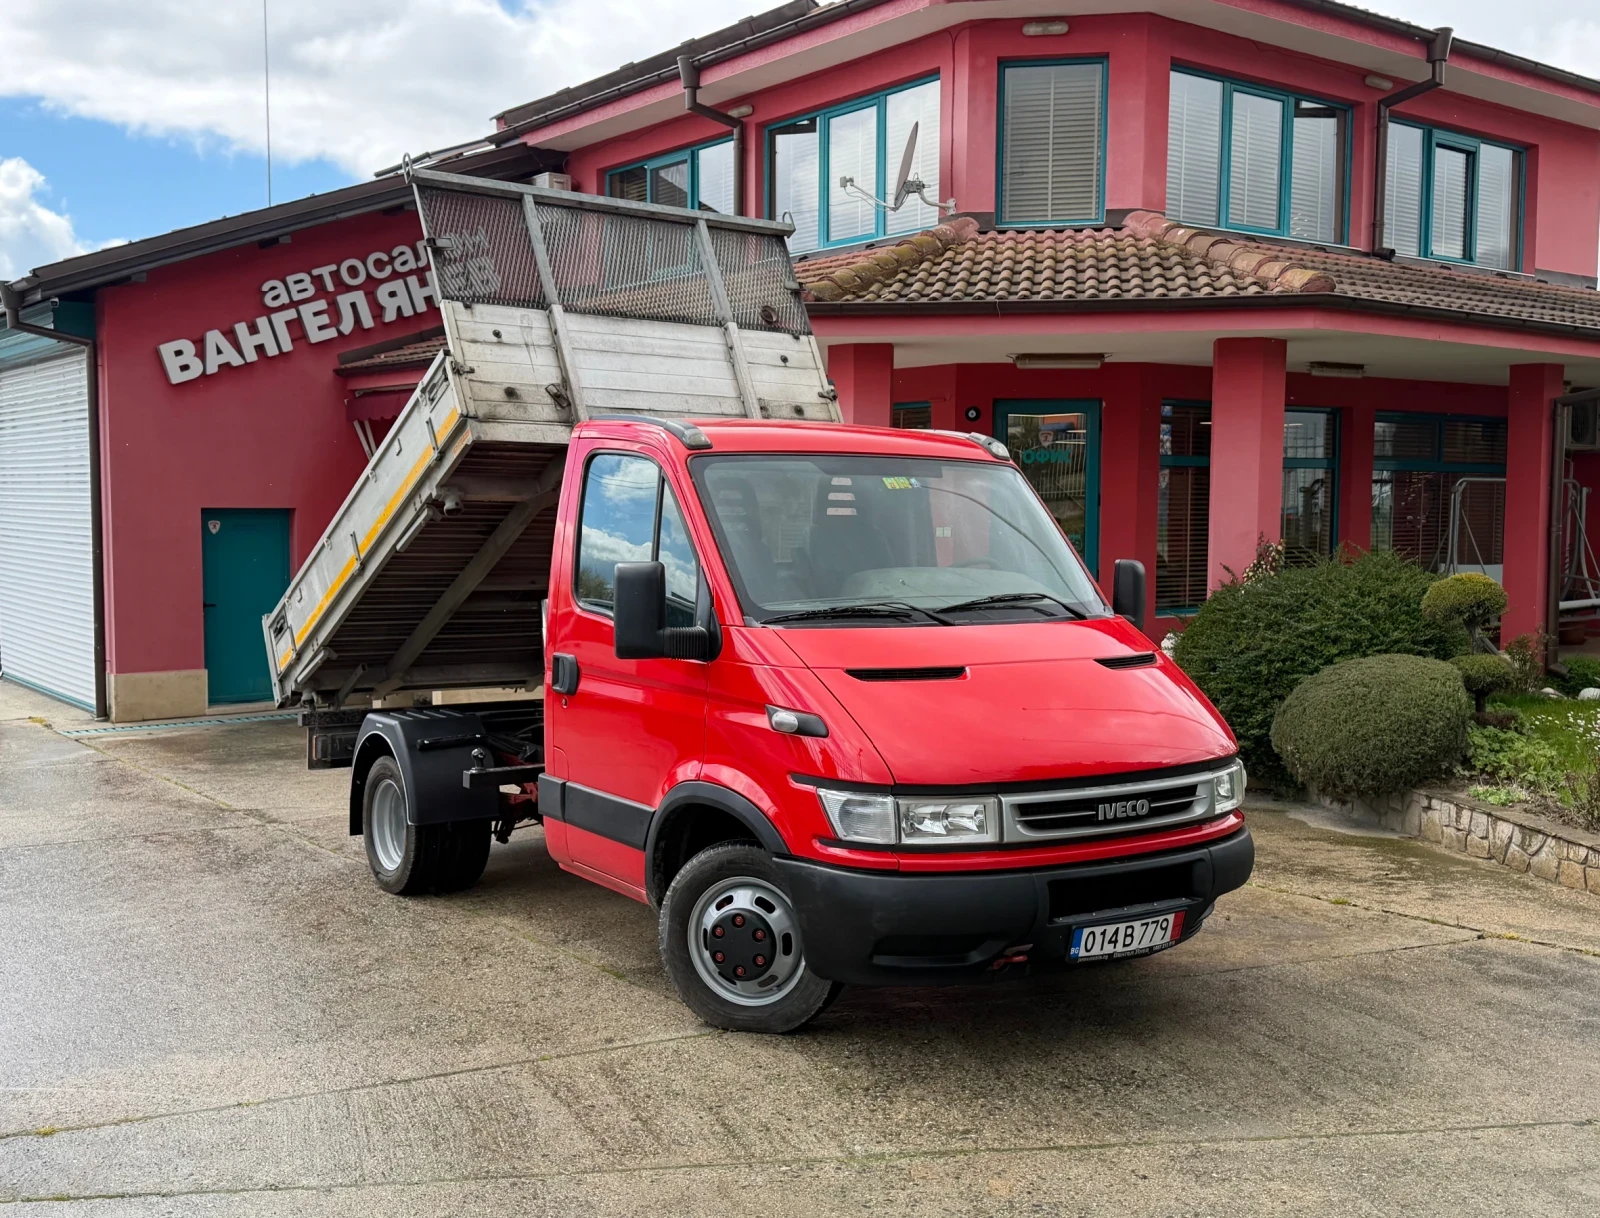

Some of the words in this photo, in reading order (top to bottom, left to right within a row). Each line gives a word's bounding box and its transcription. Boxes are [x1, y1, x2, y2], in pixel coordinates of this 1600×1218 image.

[157, 290, 375, 385] ВАНГЕЛ
[1098, 800, 1149, 820] IVECO
[1070, 946, 1080, 955] BG
